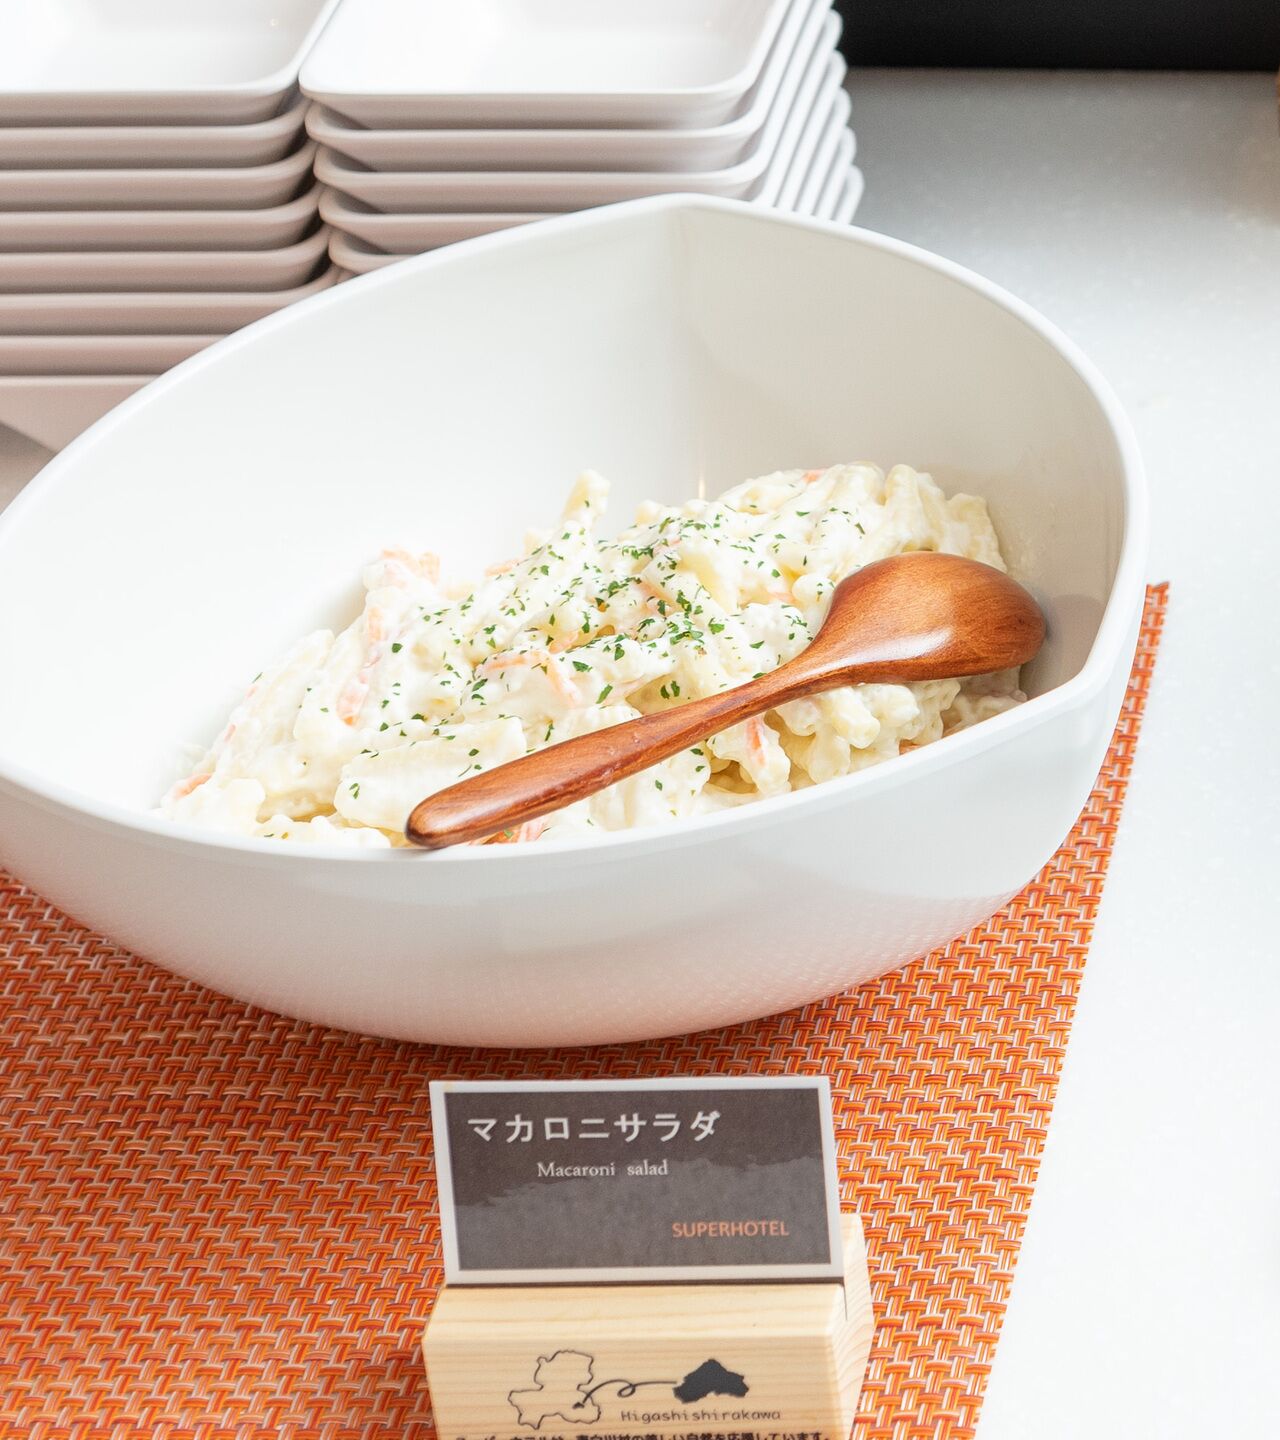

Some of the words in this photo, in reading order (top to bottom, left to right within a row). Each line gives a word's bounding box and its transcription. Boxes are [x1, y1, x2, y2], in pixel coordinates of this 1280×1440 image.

[466, 1109, 722, 1144] マカロニサラダ
[537, 1161, 616, 1178] Macaroni
[627, 1159, 669, 1177] salad
[671, 1220, 790, 1239] SUPERHOTEL
[620, 1408, 781, 1425] Higashishirakawa
